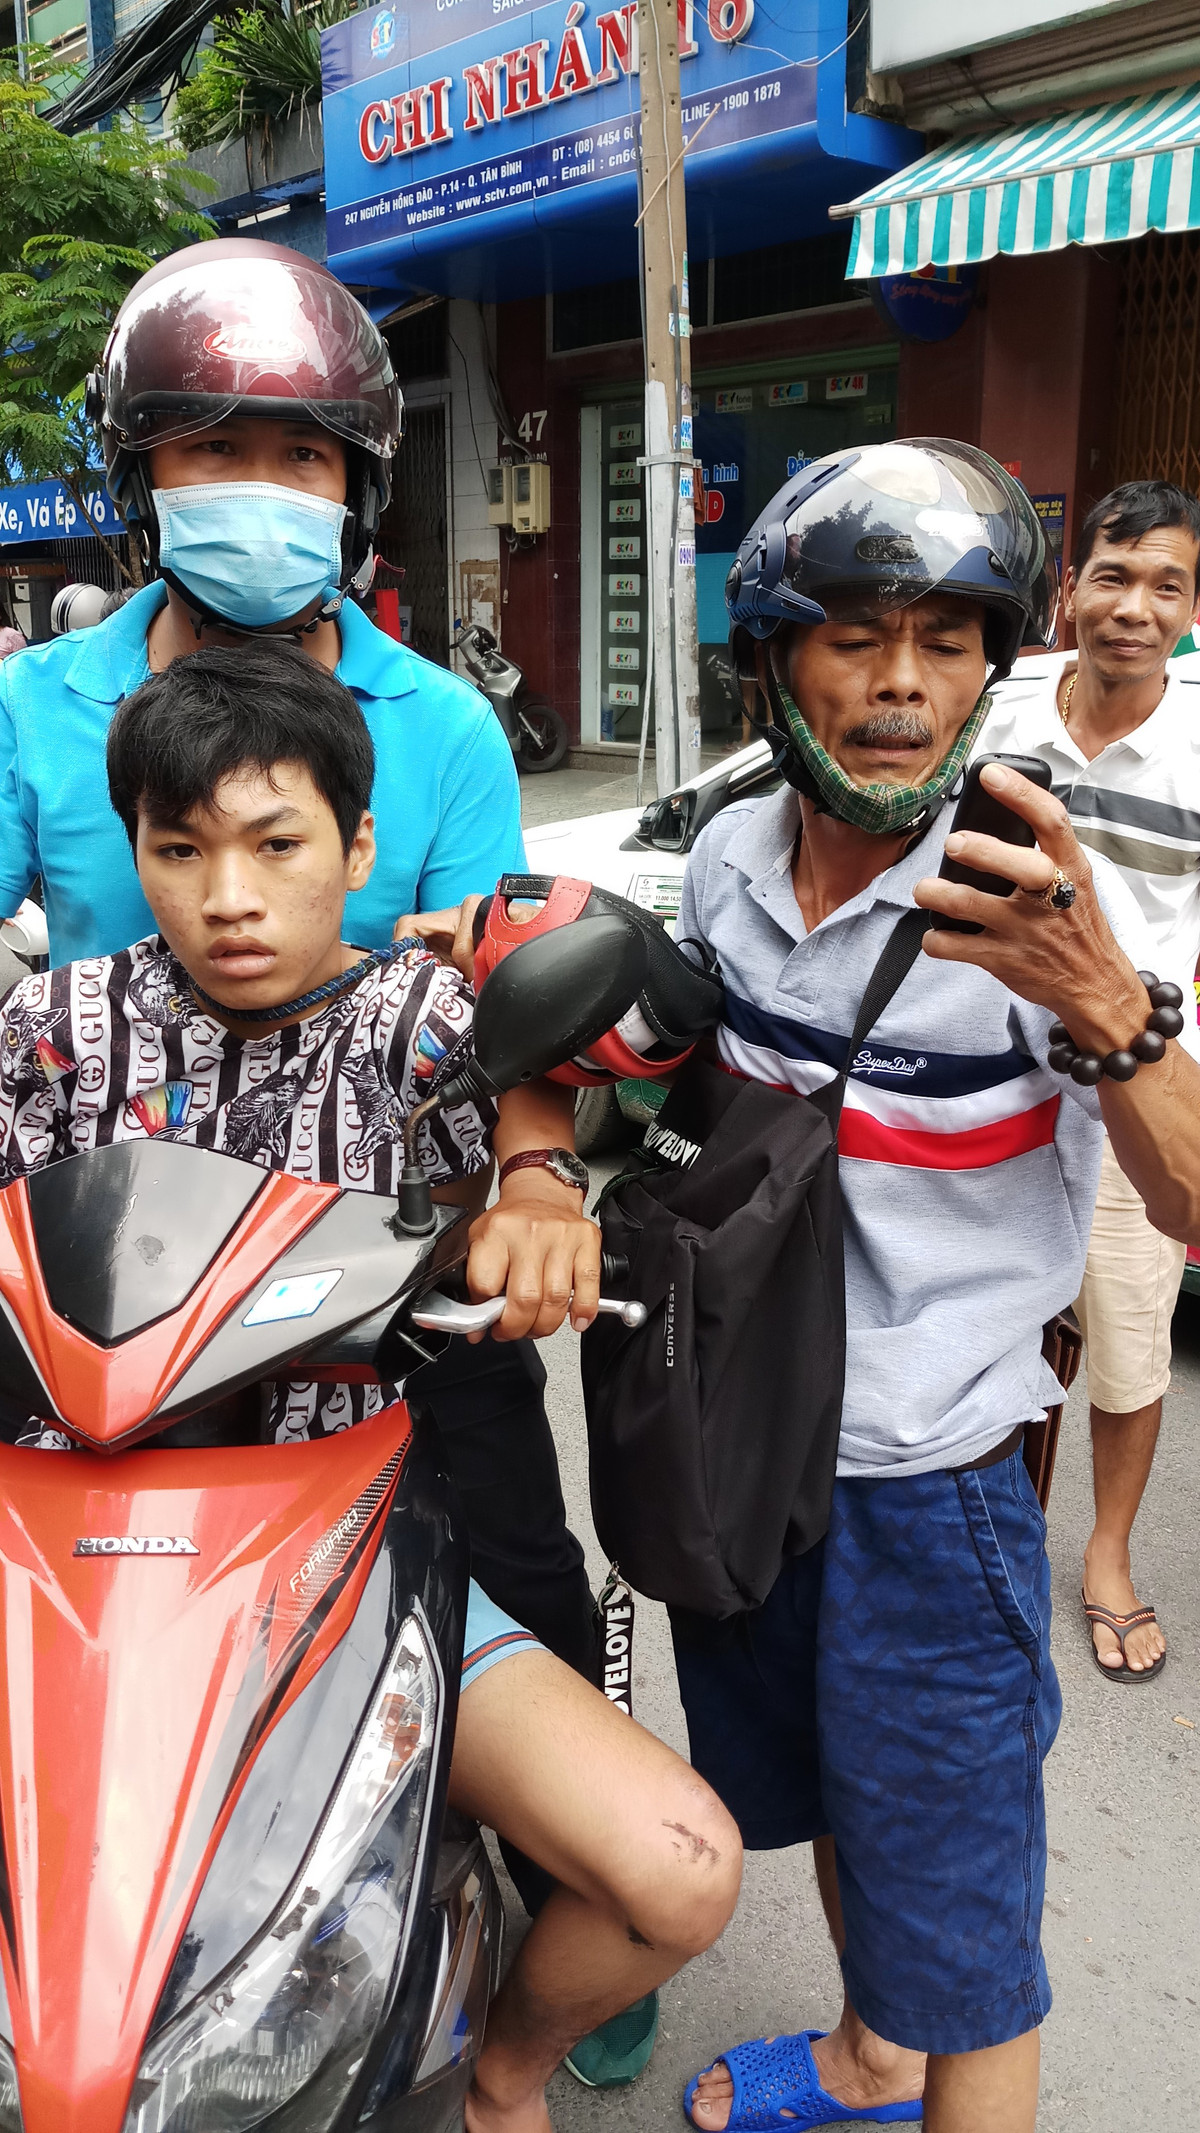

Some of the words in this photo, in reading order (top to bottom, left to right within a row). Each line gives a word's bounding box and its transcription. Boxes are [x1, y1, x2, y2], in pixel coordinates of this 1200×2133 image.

[359, 77, 454, 163] CHI
[681, 102, 710, 124] TLINE
[723, 91, 749, 112] 1900
[754, 81, 781, 103] 1878
[574, 136, 594, 158] (08)
[597, 129, 620, 149] 4454
[344, 211, 358, 226] 247
[360, 197, 391, 221] NGUYỄN
[416, 187, 433, 203] ĐÀO
[440, 179, 459, 197] P.14
[468, 174, 478, 188] Q.
[480, 166, 498, 184] TÂN
[500, 160, 522, 178] BÌNH
[406, 205, 445, 226] Website
[455, 175, 549, 211] www.sctv.com.vn
[561, 159, 596, 181] Email
[608, 146, 642, 167] cn6@
[713, 462, 739, 483] hình
[26, 498, 50, 527] Vá
[666, 1281, 676, 1368] CONVERSE
[73, 1535, 201, 1556] HONDA
[288, 1508, 359, 1595] FORWARD
